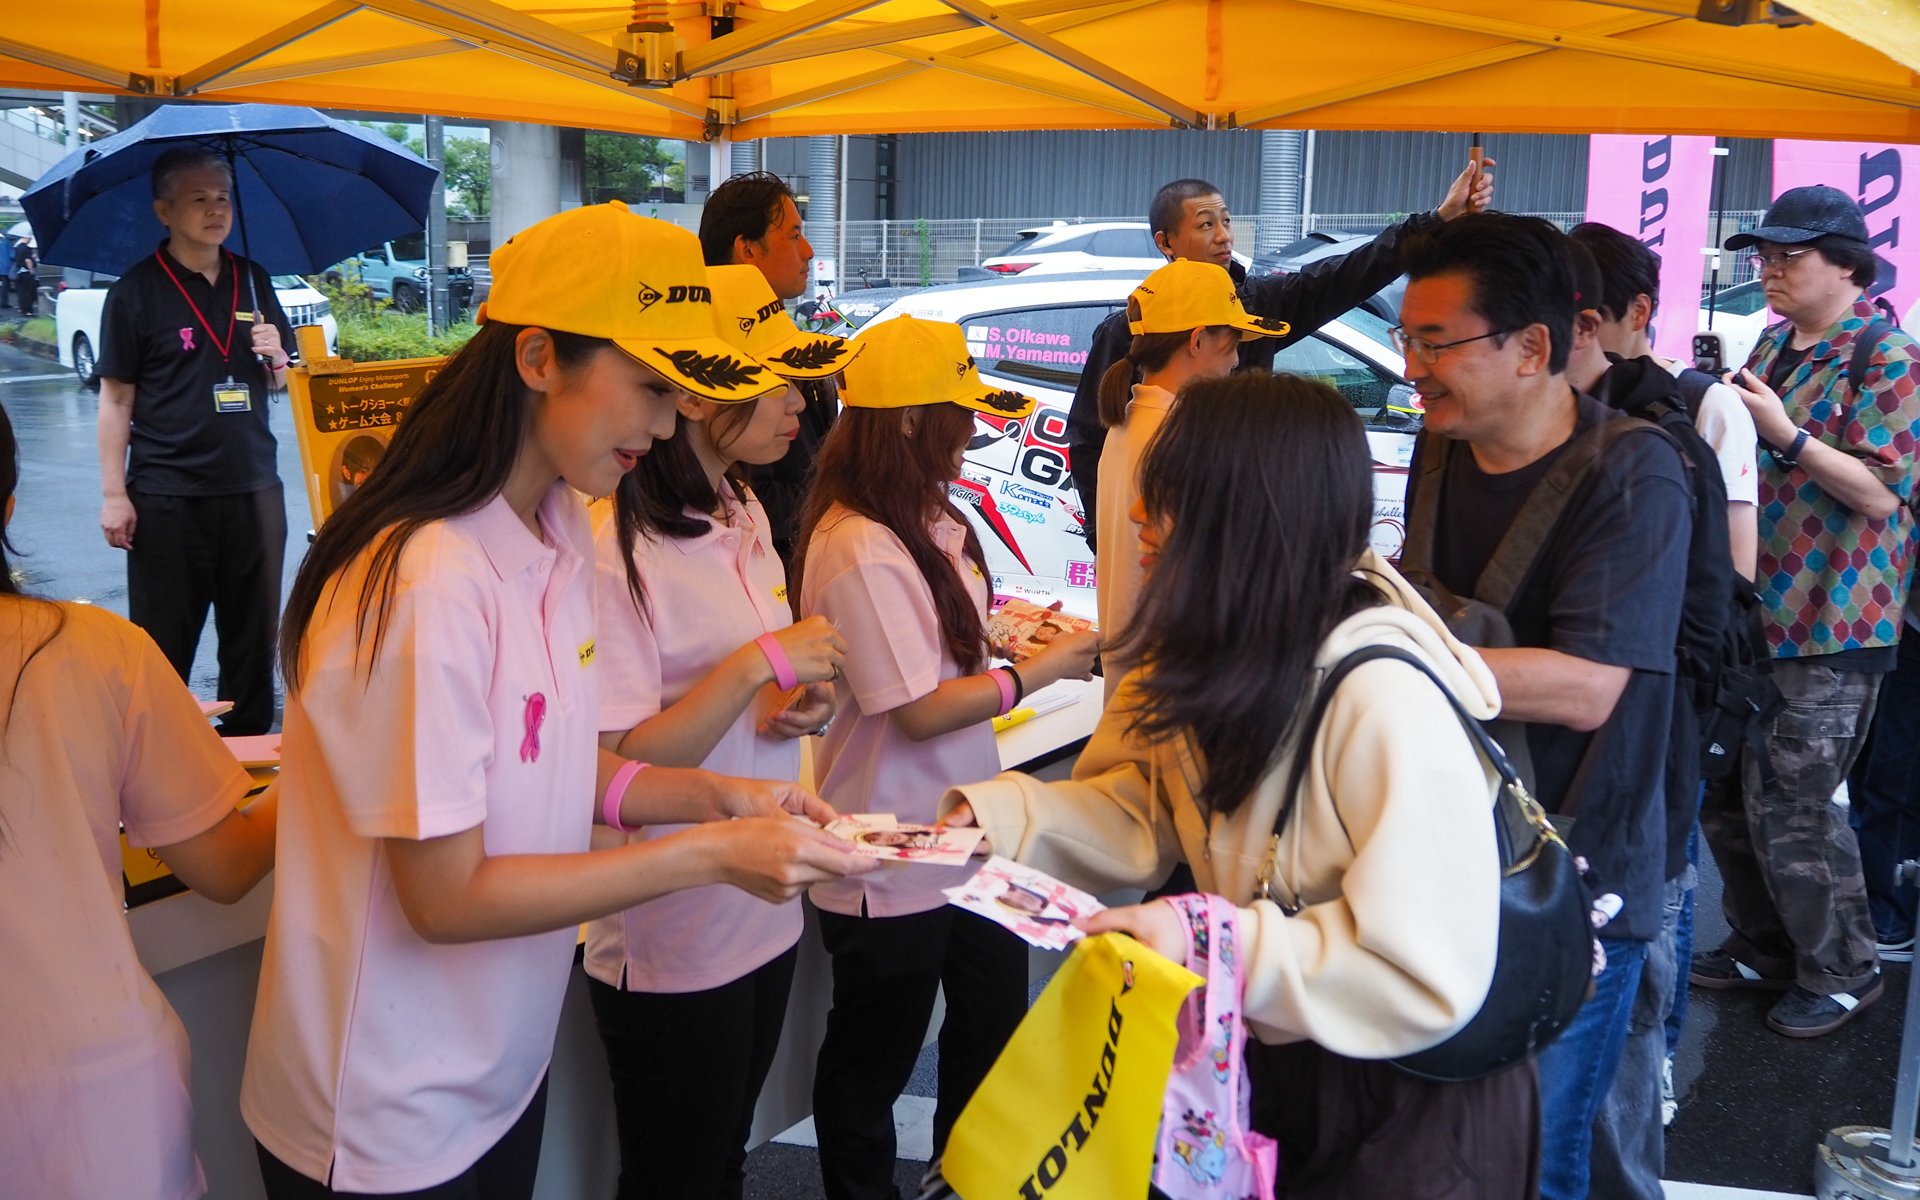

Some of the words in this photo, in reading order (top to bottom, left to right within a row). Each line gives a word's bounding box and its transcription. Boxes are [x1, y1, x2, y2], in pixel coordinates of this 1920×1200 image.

[988, 326, 1070, 346] S.Oikawa
[328, 377, 358, 386] DUNLOP
[359, 376, 375, 384] Enjoy
[375, 373, 410, 382] Motorsports
[338, 384, 369, 393] Women's
[370, 381, 404, 390] Challenge
